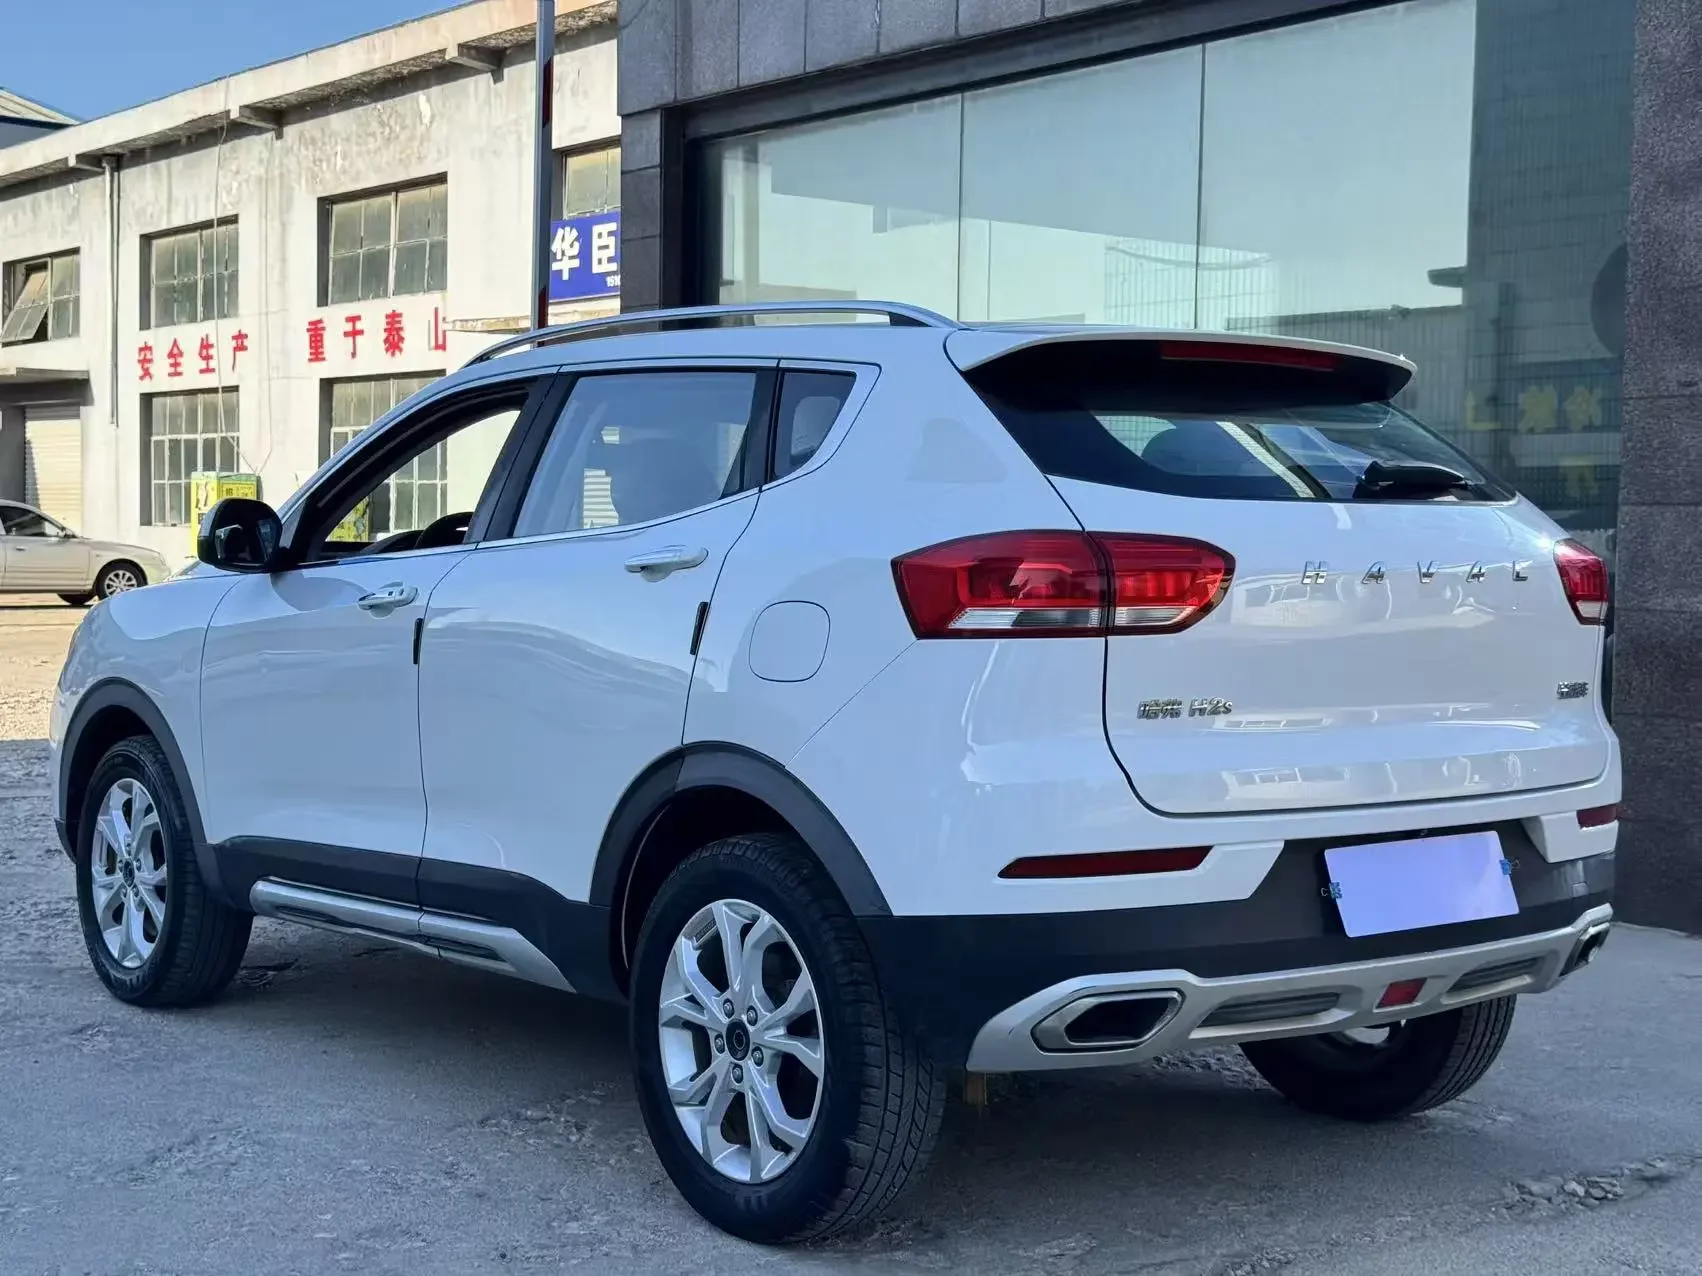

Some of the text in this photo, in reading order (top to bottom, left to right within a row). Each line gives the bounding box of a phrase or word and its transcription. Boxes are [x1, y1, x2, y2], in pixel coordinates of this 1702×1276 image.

[551, 222, 618, 280] 华臣
[137, 307, 447, 381] 安全生产 重于泰山
[1301, 560, 1529, 585] HAVAL
[1188, 696, 1233, 717] H2s
